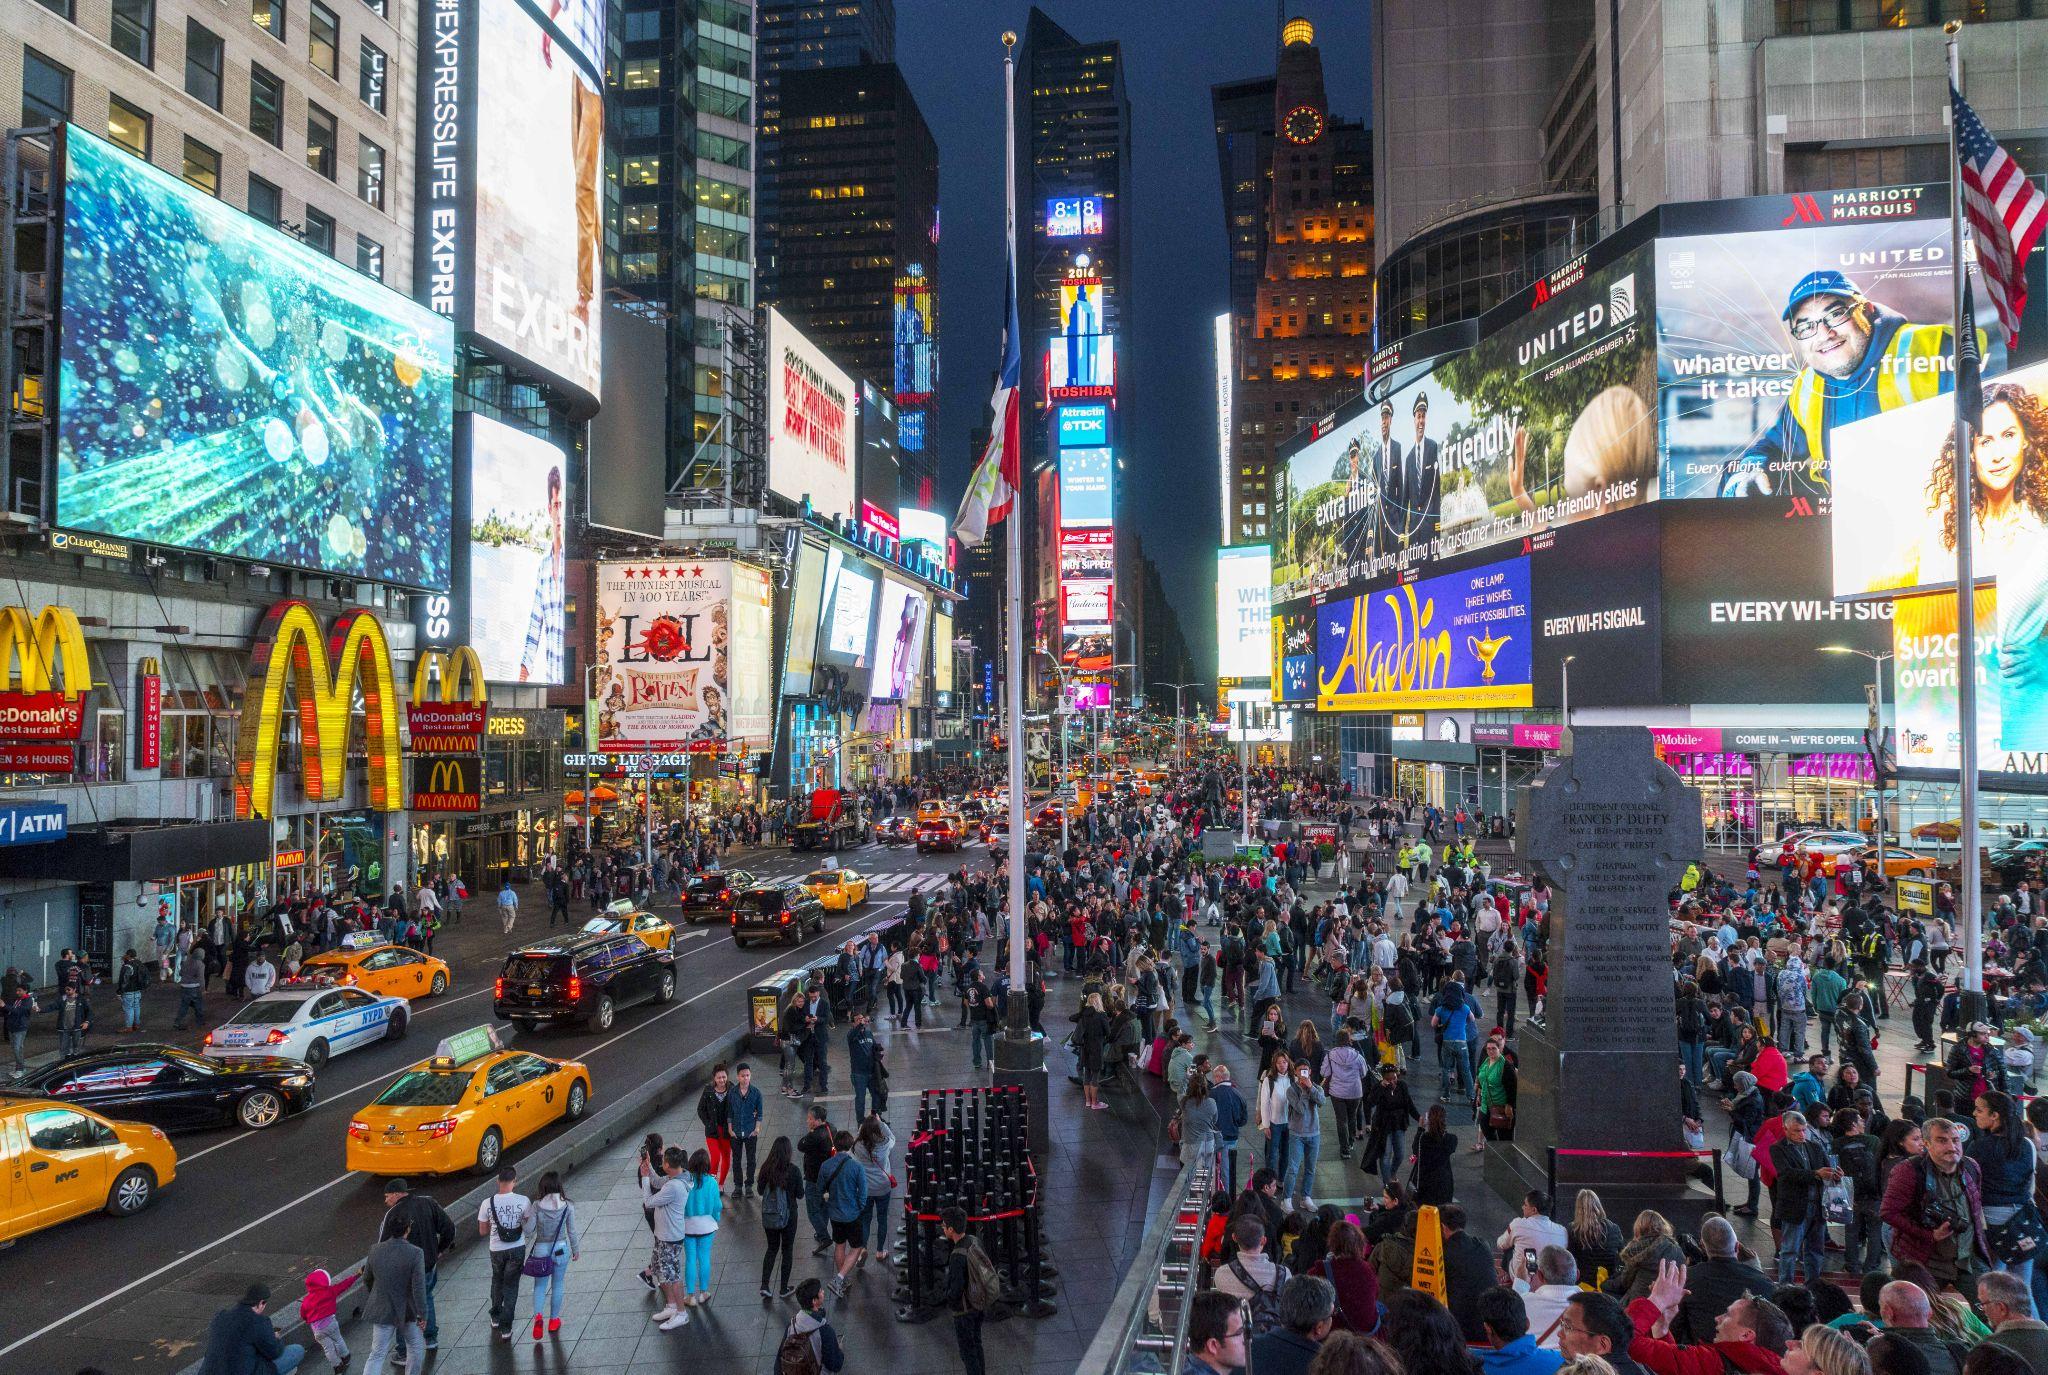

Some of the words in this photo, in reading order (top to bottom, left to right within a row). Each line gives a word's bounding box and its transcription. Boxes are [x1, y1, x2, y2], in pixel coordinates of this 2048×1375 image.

[1833, 187, 1924, 205] MARRIOTT
[1055, 200, 1095, 217] 8:18
[1833, 202, 1913, 219] MARQUIS
[1840, 248, 1944, 266] UNITED
[1068, 268, 1095, 279] 2016
[1550, 254, 1588, 284] MARRIOTT
[1899, 271, 1931, 280] ALLIANCE
[1062, 277, 1101, 286] TOSHIBA
[1550, 269, 1584, 296] MARQUIS
[1518, 304, 1604, 366] UNITED
[1549, 365, 1567, 379] STAR
[1565, 350, 1595, 374] ALLIANCE
[1594, 337, 1624, 357] MEMBER
[1673, 352, 1793, 376] whatever
[1051, 385, 1113, 398] TOSHIBA
[1702, 379, 1720, 400] it
[1725, 377, 1794, 400] takes
[1072, 420, 1103, 431] TDK
[1440, 416, 1519, 474] friendly
[1686, 463, 1723, 475] Every
[1727, 459, 1765, 473] flight,
[1768, 459, 1807, 472] every
[1316, 493, 1346, 527] extra
[1348, 477, 1377, 514] mile
[1349, 559, 1360, 578] off
[1361, 560, 1369, 575] to
[1399, 542, 1428, 566] putting
[1431, 535, 1445, 554] the
[1447, 523, 1491, 551] customer
[1493, 515, 1517, 536] first.
[1521, 509, 1535, 529] fly
[1537, 504, 1556, 522] the
[1556, 489, 1604, 518] friendly
[1604, 479, 1639, 505] skies
[1532, 531, 1556, 542] MARRIOTT
[1082, 559, 1111, 570] SIPPED
[607, 581, 625, 591] THE
[628, 580, 675, 591] FUNNIEST
[678, 579, 721, 590] MUSICAL
[1471, 578, 1485, 590] ONE
[1485, 573, 1506, 588] LAMP.
[624, 591, 637, 603] IN
[640, 591, 662, 602] 400
[1465, 596, 1485, 609] THREE
[1486, 589, 1513, 604] WISHES.
[1453, 611, 1479, 627] INFINITE
[1479, 604, 1527, 623] POSSIBILITIES.
[1711, 601, 1788, 623] EVERY
[1791, 601, 1851, 622] WI-FI
[1543, 615, 1576, 637] EVERY
[1577, 611, 1602, 633] WI-FI
[1603, 606, 1646, 631] SIGNAL
[1318, 583, 1452, 696] Aladdin
[1900, 662, 1987, 689] ovarin
[149, 680, 157, 713] OPEN
[147, 714, 157, 722] 24
[411, 711, 482, 723] McDonald's
[422, 723, 470, 731] Restaurant
[148, 724, 156, 763] HOURS
[1735, 735, 1766, 745] COME
[1768, 735, 1779, 745] IN
[1791, 735, 1824, 745] WE'RE
[1825, 735, 1858, 745] OPEN.
[1911, 746, 1934, 754] CANCER
[16, 755, 29, 764] 24
[32, 755, 70, 764] HOURS
[19, 813, 63, 834] ATM
[1562, 813, 1613, 825] FRANCIS
[1628, 813, 1669, 825] DUFFY
[1576, 841, 1620, 850] CATHOLIC
[1624, 841, 1656, 850] PRIEST
[1595, 862, 1637, 870] CHAPLAIN
[1900, 886, 1930, 901] Beautiful
[362, 1007, 383, 1025] NYPD
[227, 1031, 248, 1039] NYPD
[55, 1168, 80, 1184] NYC
[1417, 1280, 1433, 1290] WET
